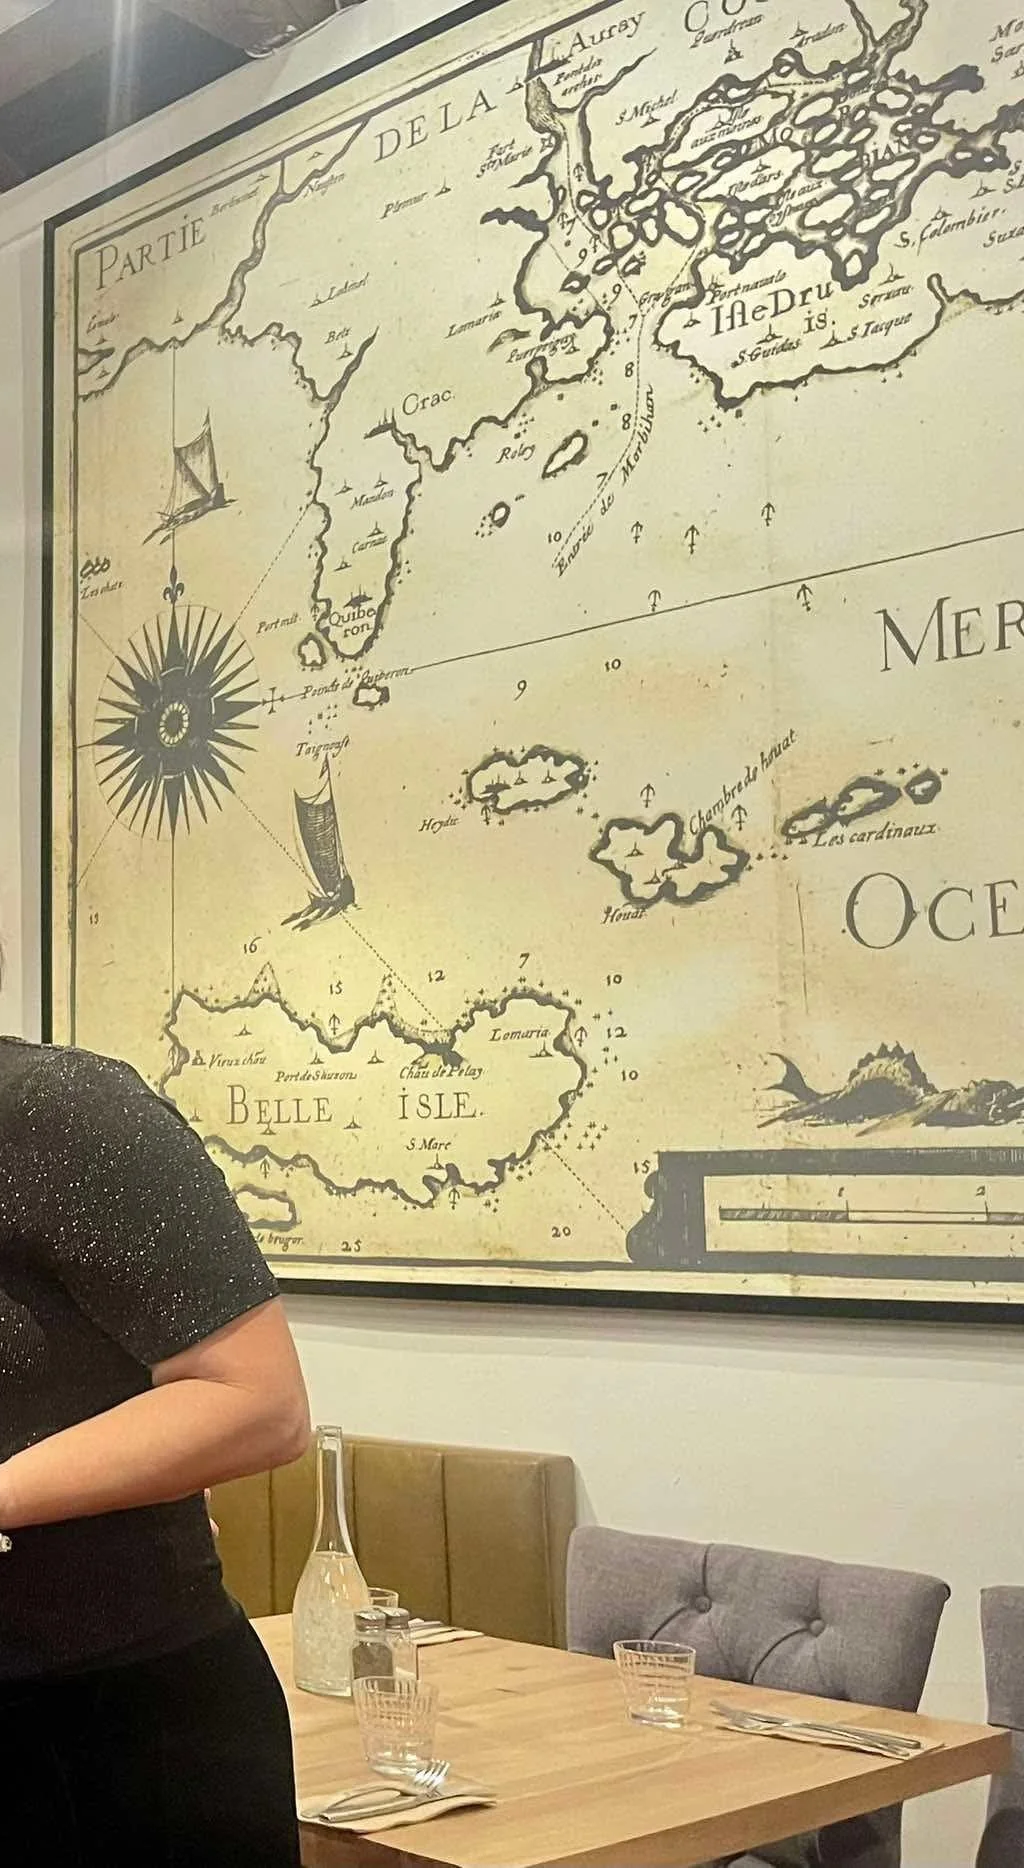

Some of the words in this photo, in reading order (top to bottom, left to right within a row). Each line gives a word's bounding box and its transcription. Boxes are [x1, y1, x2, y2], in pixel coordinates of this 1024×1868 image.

[567, 11, 645, 58] Auray
[374, 114, 429, 163] DE
[439, 89, 497, 134] LA
[95, 214, 208, 291] PARTIE
[574, 247, 588, 269] 9
[609, 283, 622, 305] 9
[629, 314, 638, 329] 7
[625, 361, 634, 377] 8
[622, 413, 631, 430] 8
[547, 531, 563, 544] 10
[344, 622, 372, 638] ron
[874, 596, 1024, 673] MER
[604, 658, 621, 673] 10
[514, 679, 527, 702] 9
[812, 831, 845, 848] Les
[848, 821, 938, 846] cardinaux
[845, 871, 1024, 950] OCE
[243, 936, 262, 954] 16
[519, 953, 530, 969] 7
[428, 969, 446, 984] 12
[606, 974, 623, 986] 10
[330, 980, 344, 996] 15
[607, 1026, 627, 1039] 12
[621, 1069, 638, 1082] 10
[227, 1083, 333, 1126] BELLE
[633, 1159, 650, 1174] 15
[551, 1226, 572, 1239] 20
[341, 1240, 362, 1252] 25
